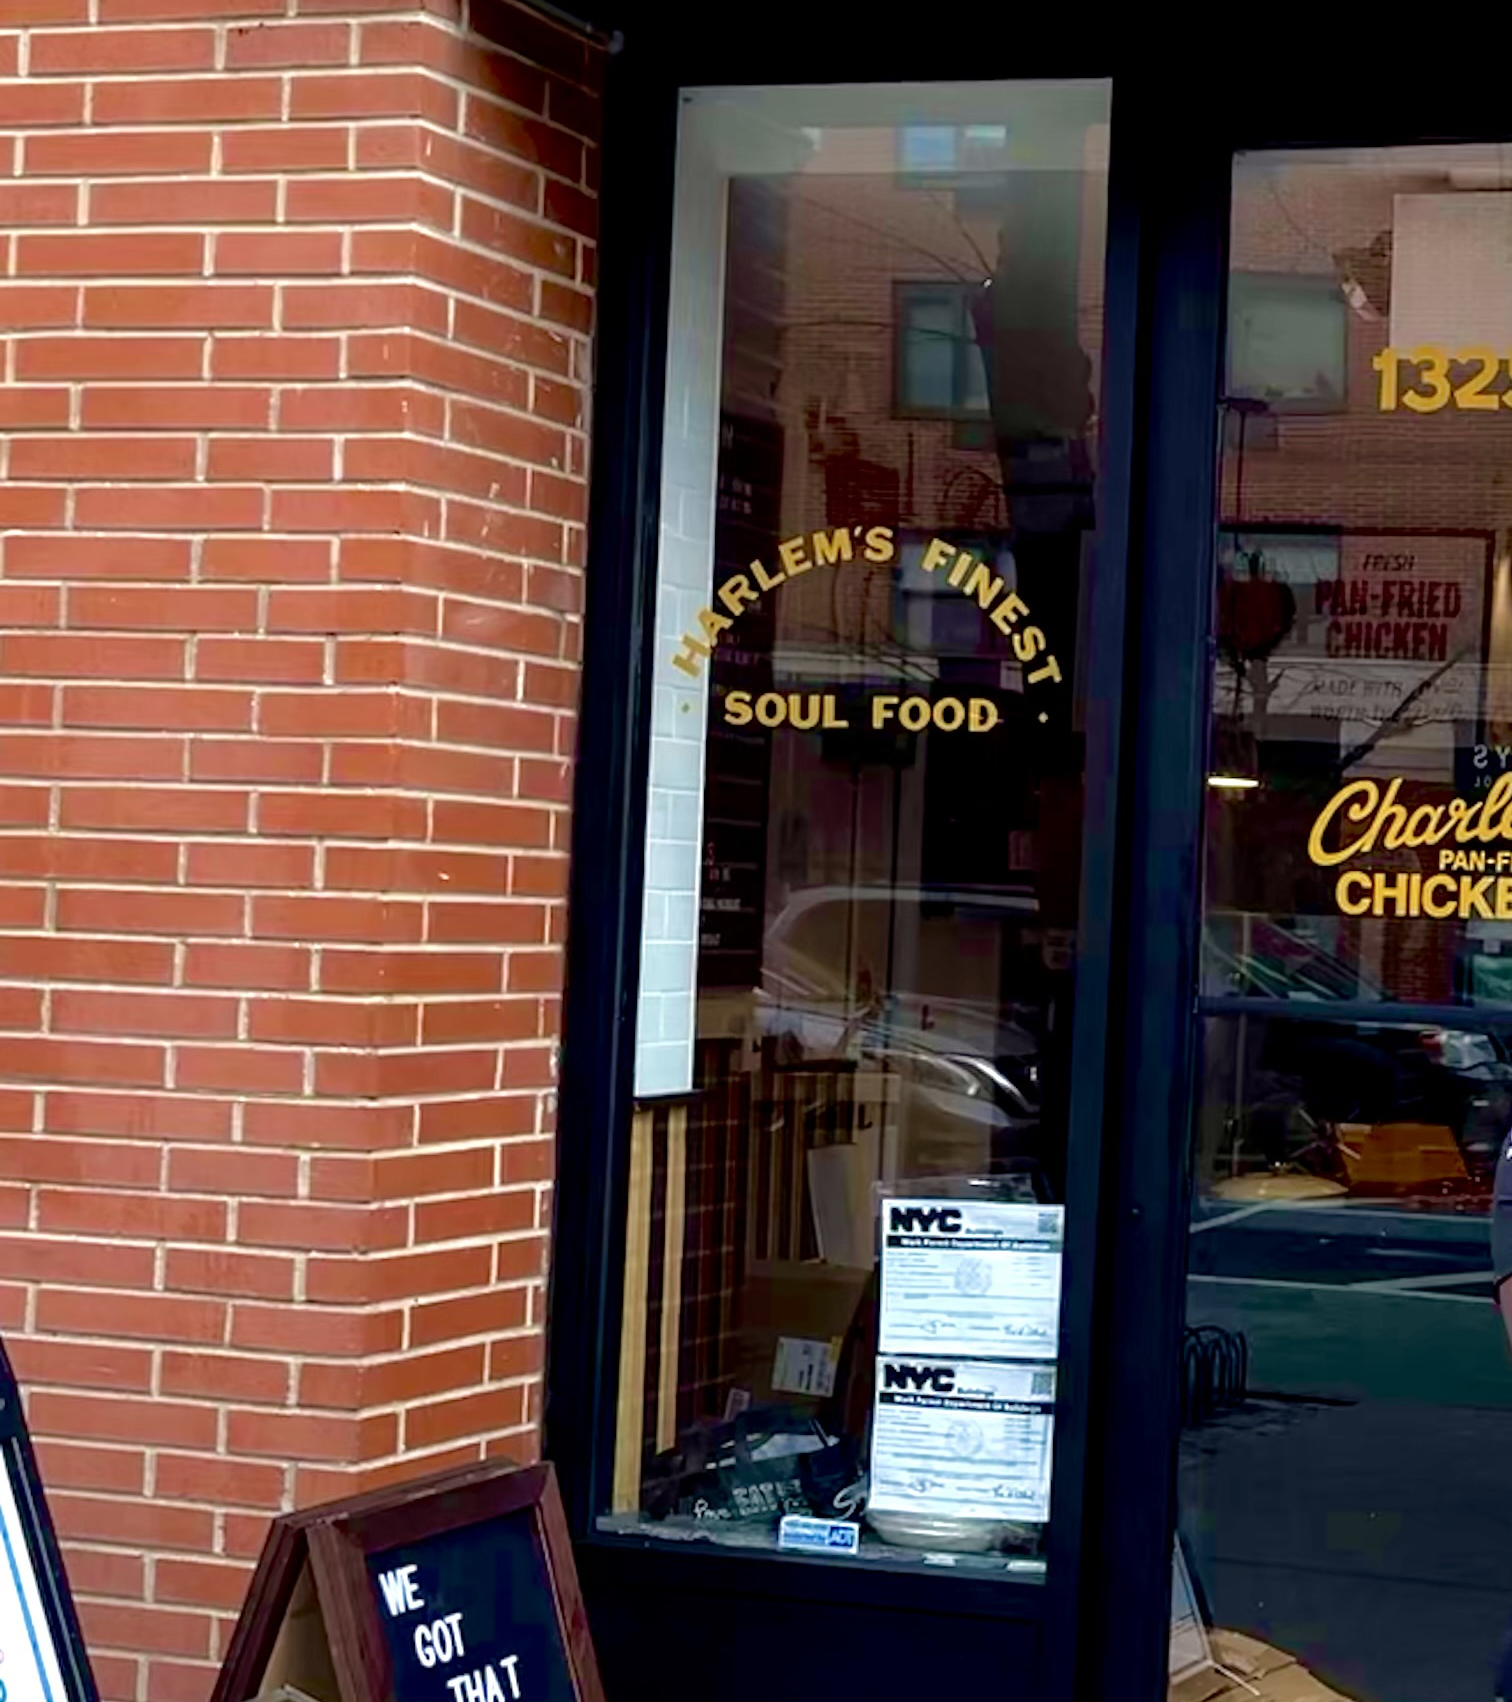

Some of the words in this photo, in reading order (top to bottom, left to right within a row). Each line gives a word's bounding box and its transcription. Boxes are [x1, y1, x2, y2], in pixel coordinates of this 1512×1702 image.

[672, 526, 895, 678] HARLEM'S
[919, 537, 1063, 685] FINEST
[1314, 578, 1462, 619] PAN-FRIED
[1325, 620, 1448, 661] CHICKEN
[723, 690, 849, 730] SOUL
[872, 695, 999, 733] FOOD
[890, 1207, 963, 1233] NYC
[884, 1363, 956, 1392] NYC
[829, 1529, 854, 1546] ADT
[378, 1564, 425, 1617] WE
[414, 1612, 466, 1669] GOT
[446, 1654, 521, 1702] THAT
